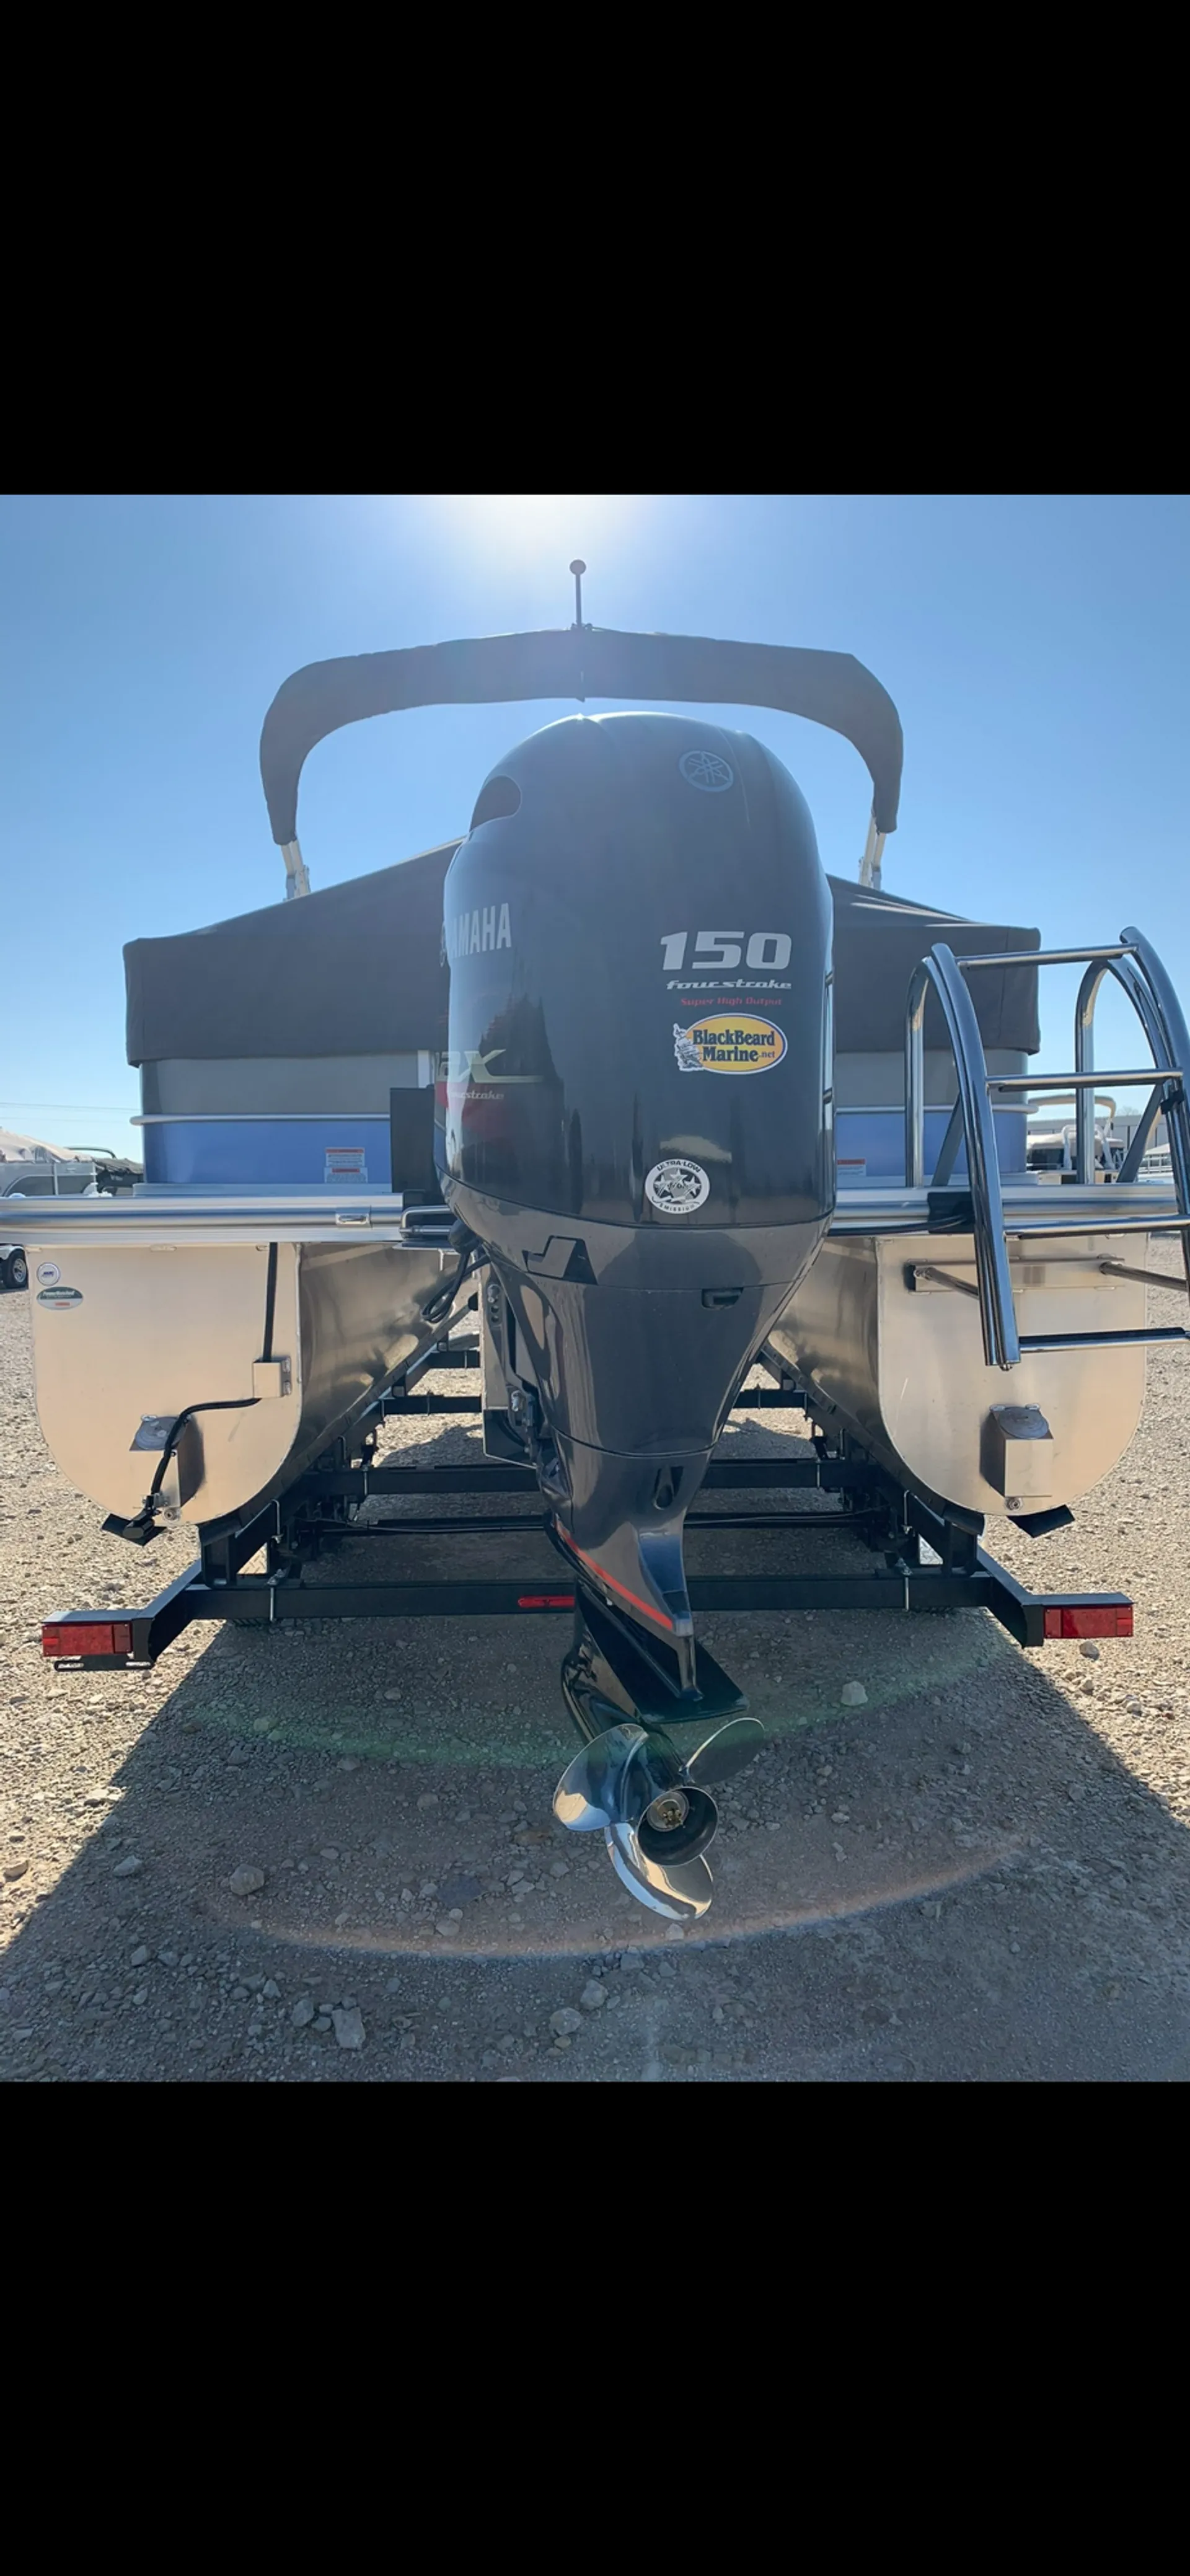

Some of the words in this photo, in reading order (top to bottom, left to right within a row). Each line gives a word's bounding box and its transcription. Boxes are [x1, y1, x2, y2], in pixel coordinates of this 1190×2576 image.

[660, 931, 792, 971] 150
[666, 979, 792, 990] fourstroke
[681, 997, 714, 1007] Super
[717, 997, 743, 1005] High
[746, 997, 782, 1007] Output
[693, 1030, 775, 1046] BlackBeard
